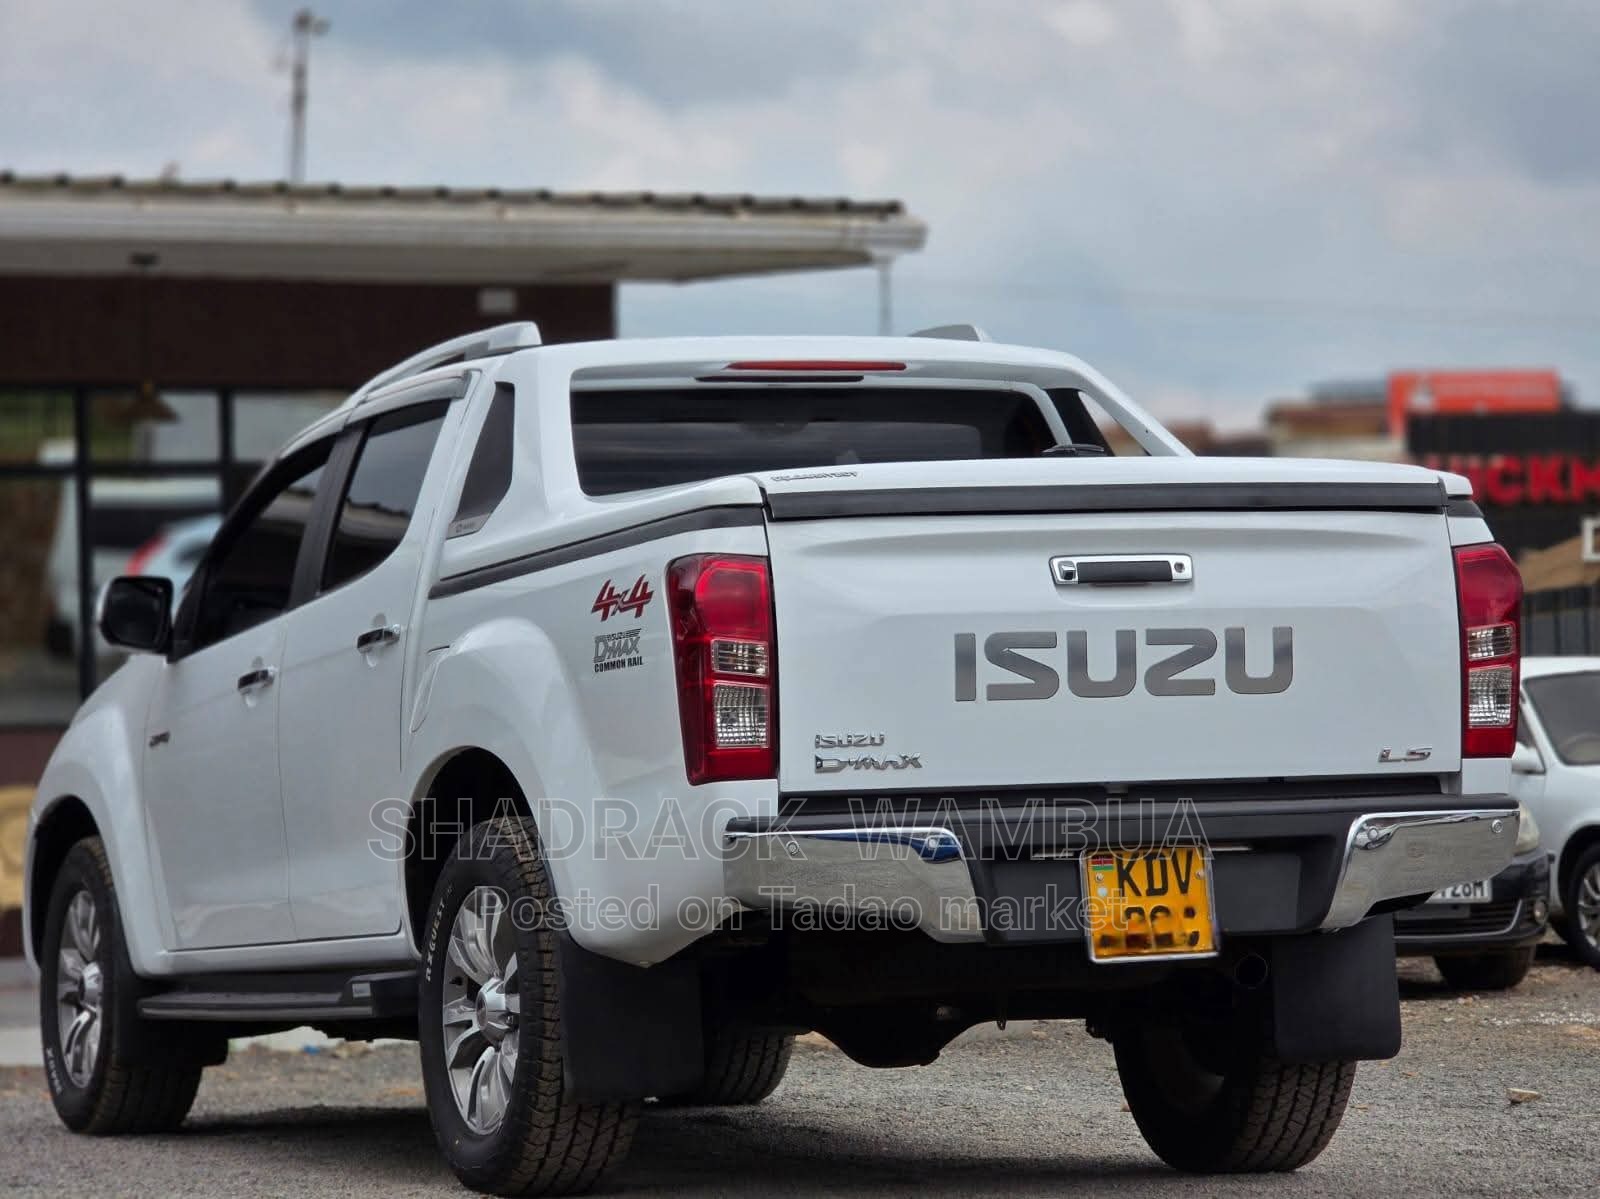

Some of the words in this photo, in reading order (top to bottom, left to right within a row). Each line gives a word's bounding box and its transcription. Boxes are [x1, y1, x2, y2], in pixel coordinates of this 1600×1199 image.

[594, 660, 626, 672] COMMON
[627, 656, 643, 667] RAIL
[954, 626, 1293, 702] ISUZU
[814, 733, 885, 748] ISUZU
[1116, 851, 1194, 897] KDV
